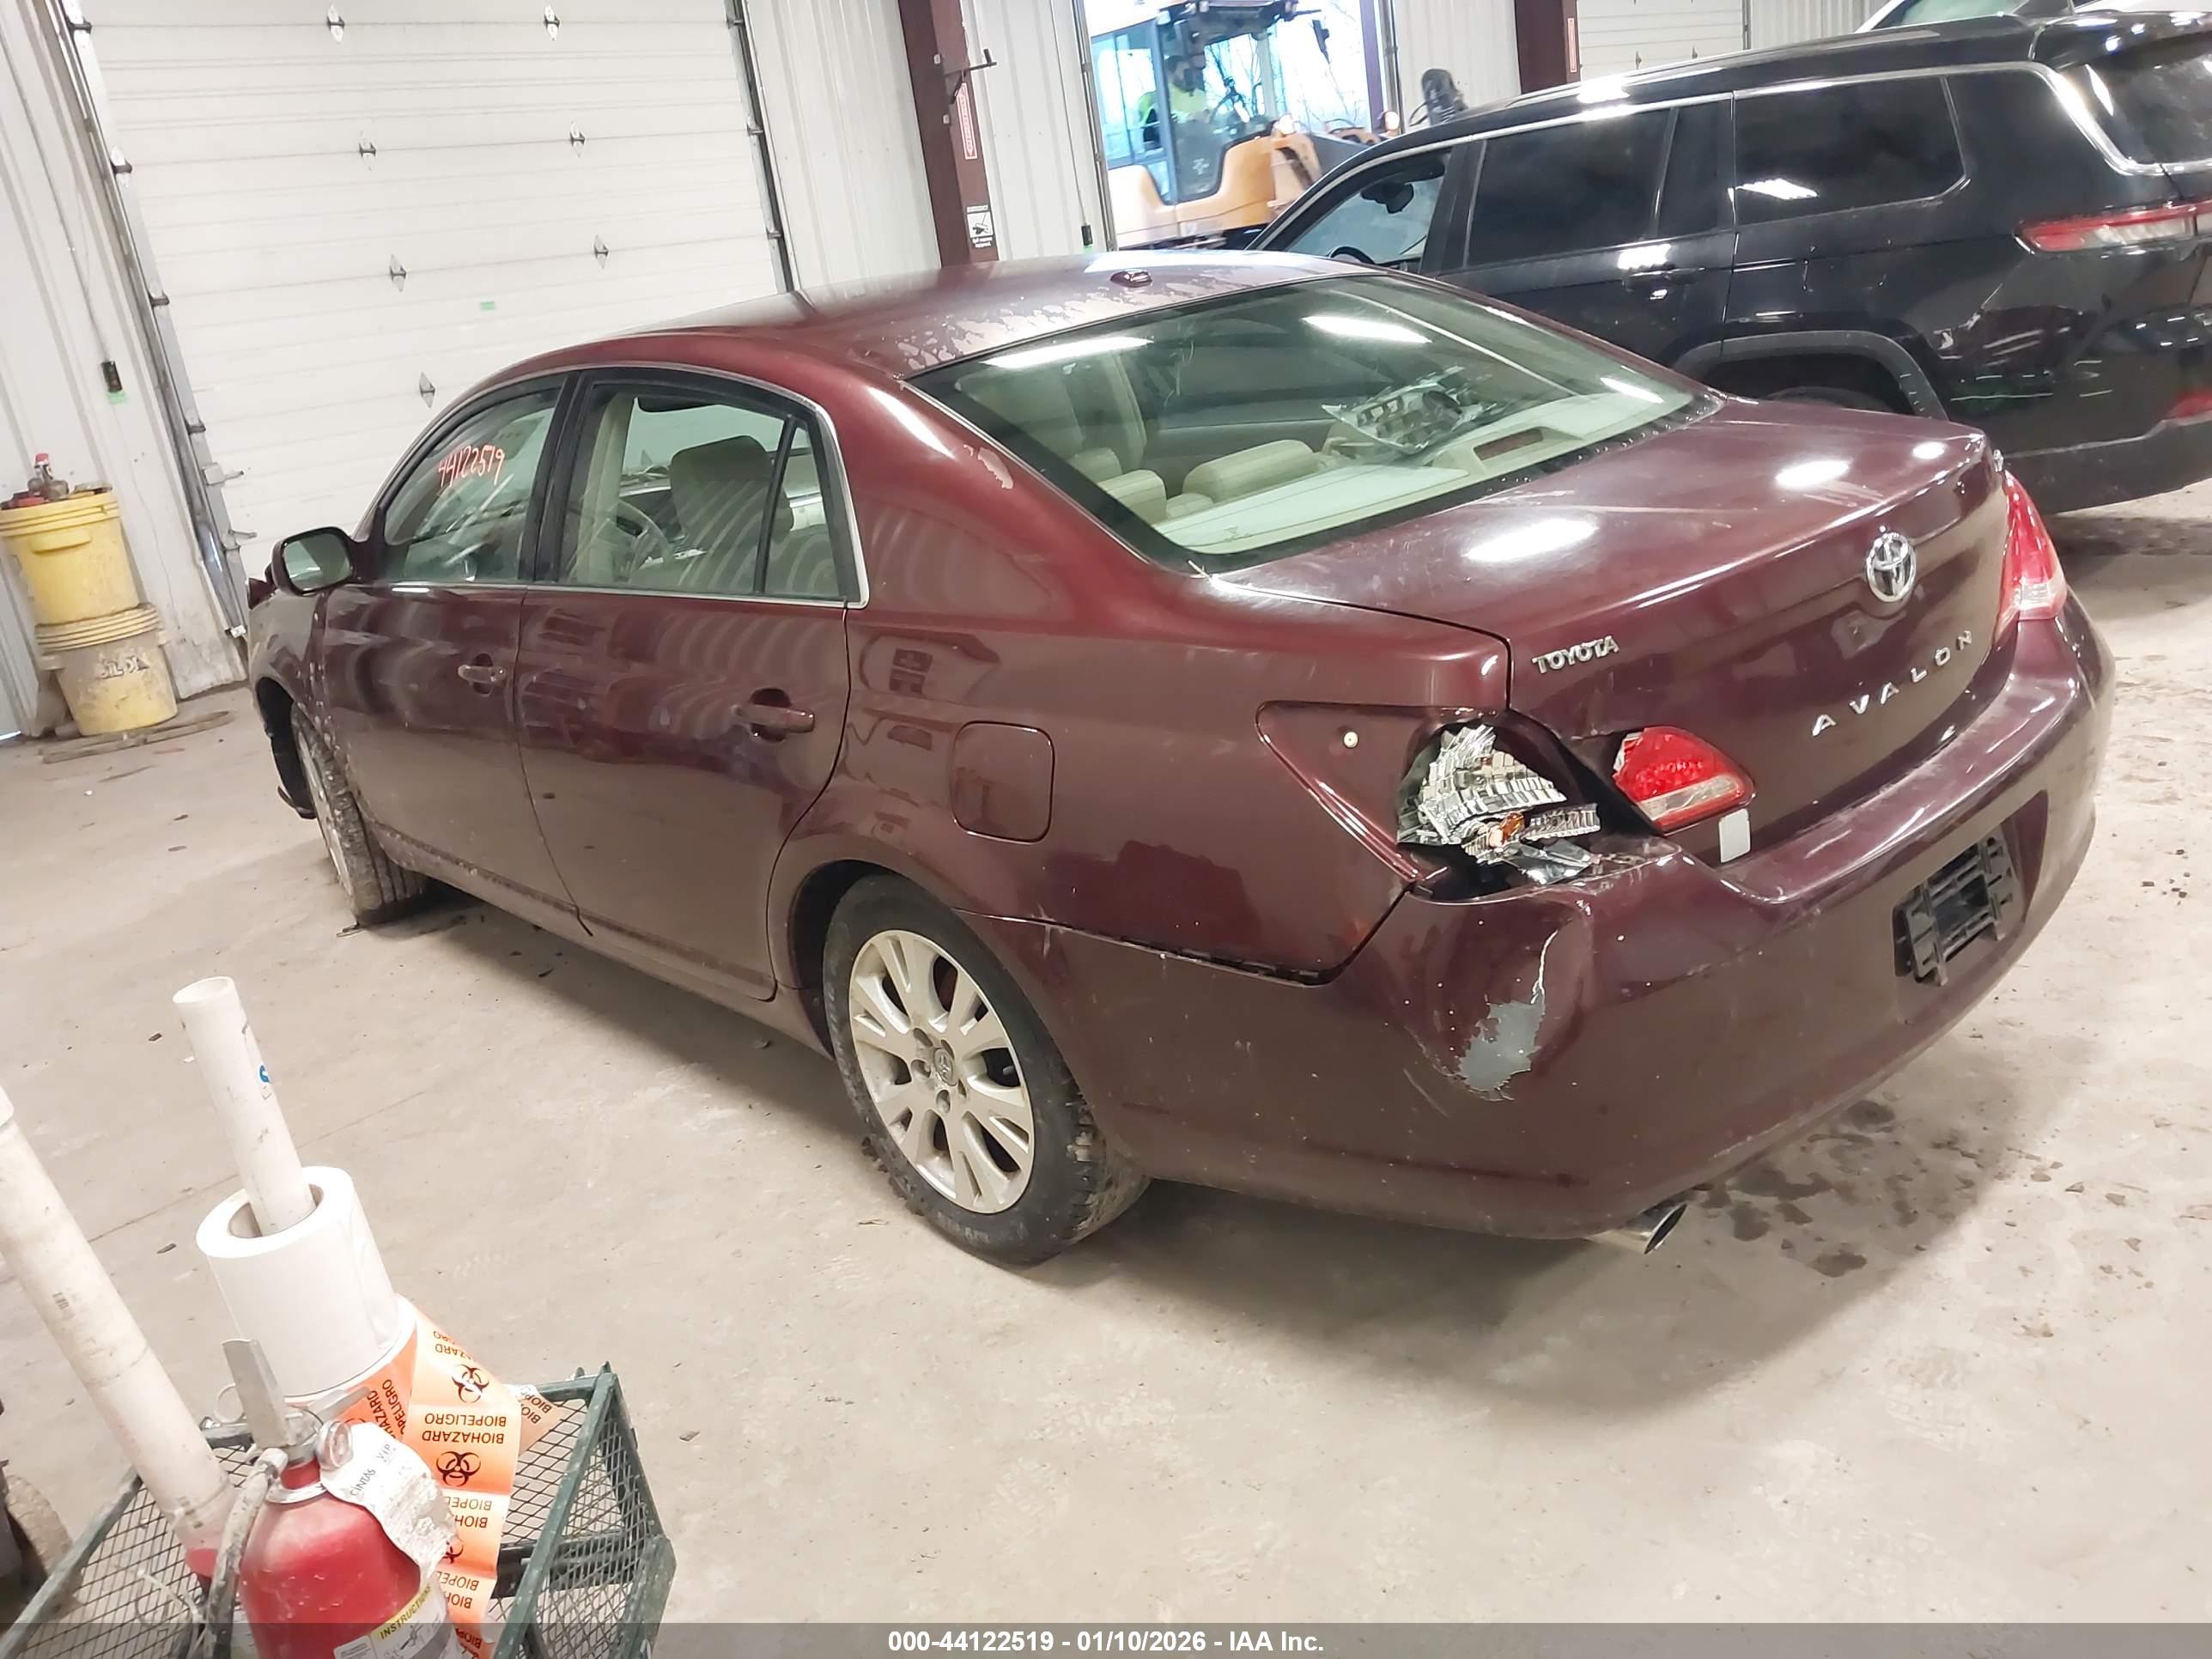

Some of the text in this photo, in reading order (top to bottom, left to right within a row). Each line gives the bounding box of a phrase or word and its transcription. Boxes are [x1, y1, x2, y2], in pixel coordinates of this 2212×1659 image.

[1531, 635, 1620, 674] TOYOTA
[1812, 630, 1973, 737] AVALON
[425, 1413, 507, 1426] BIOPELIGRO
[422, 1431, 504, 1443] BIOHAZARD
[349, 1468, 376, 1496] CINTAS
